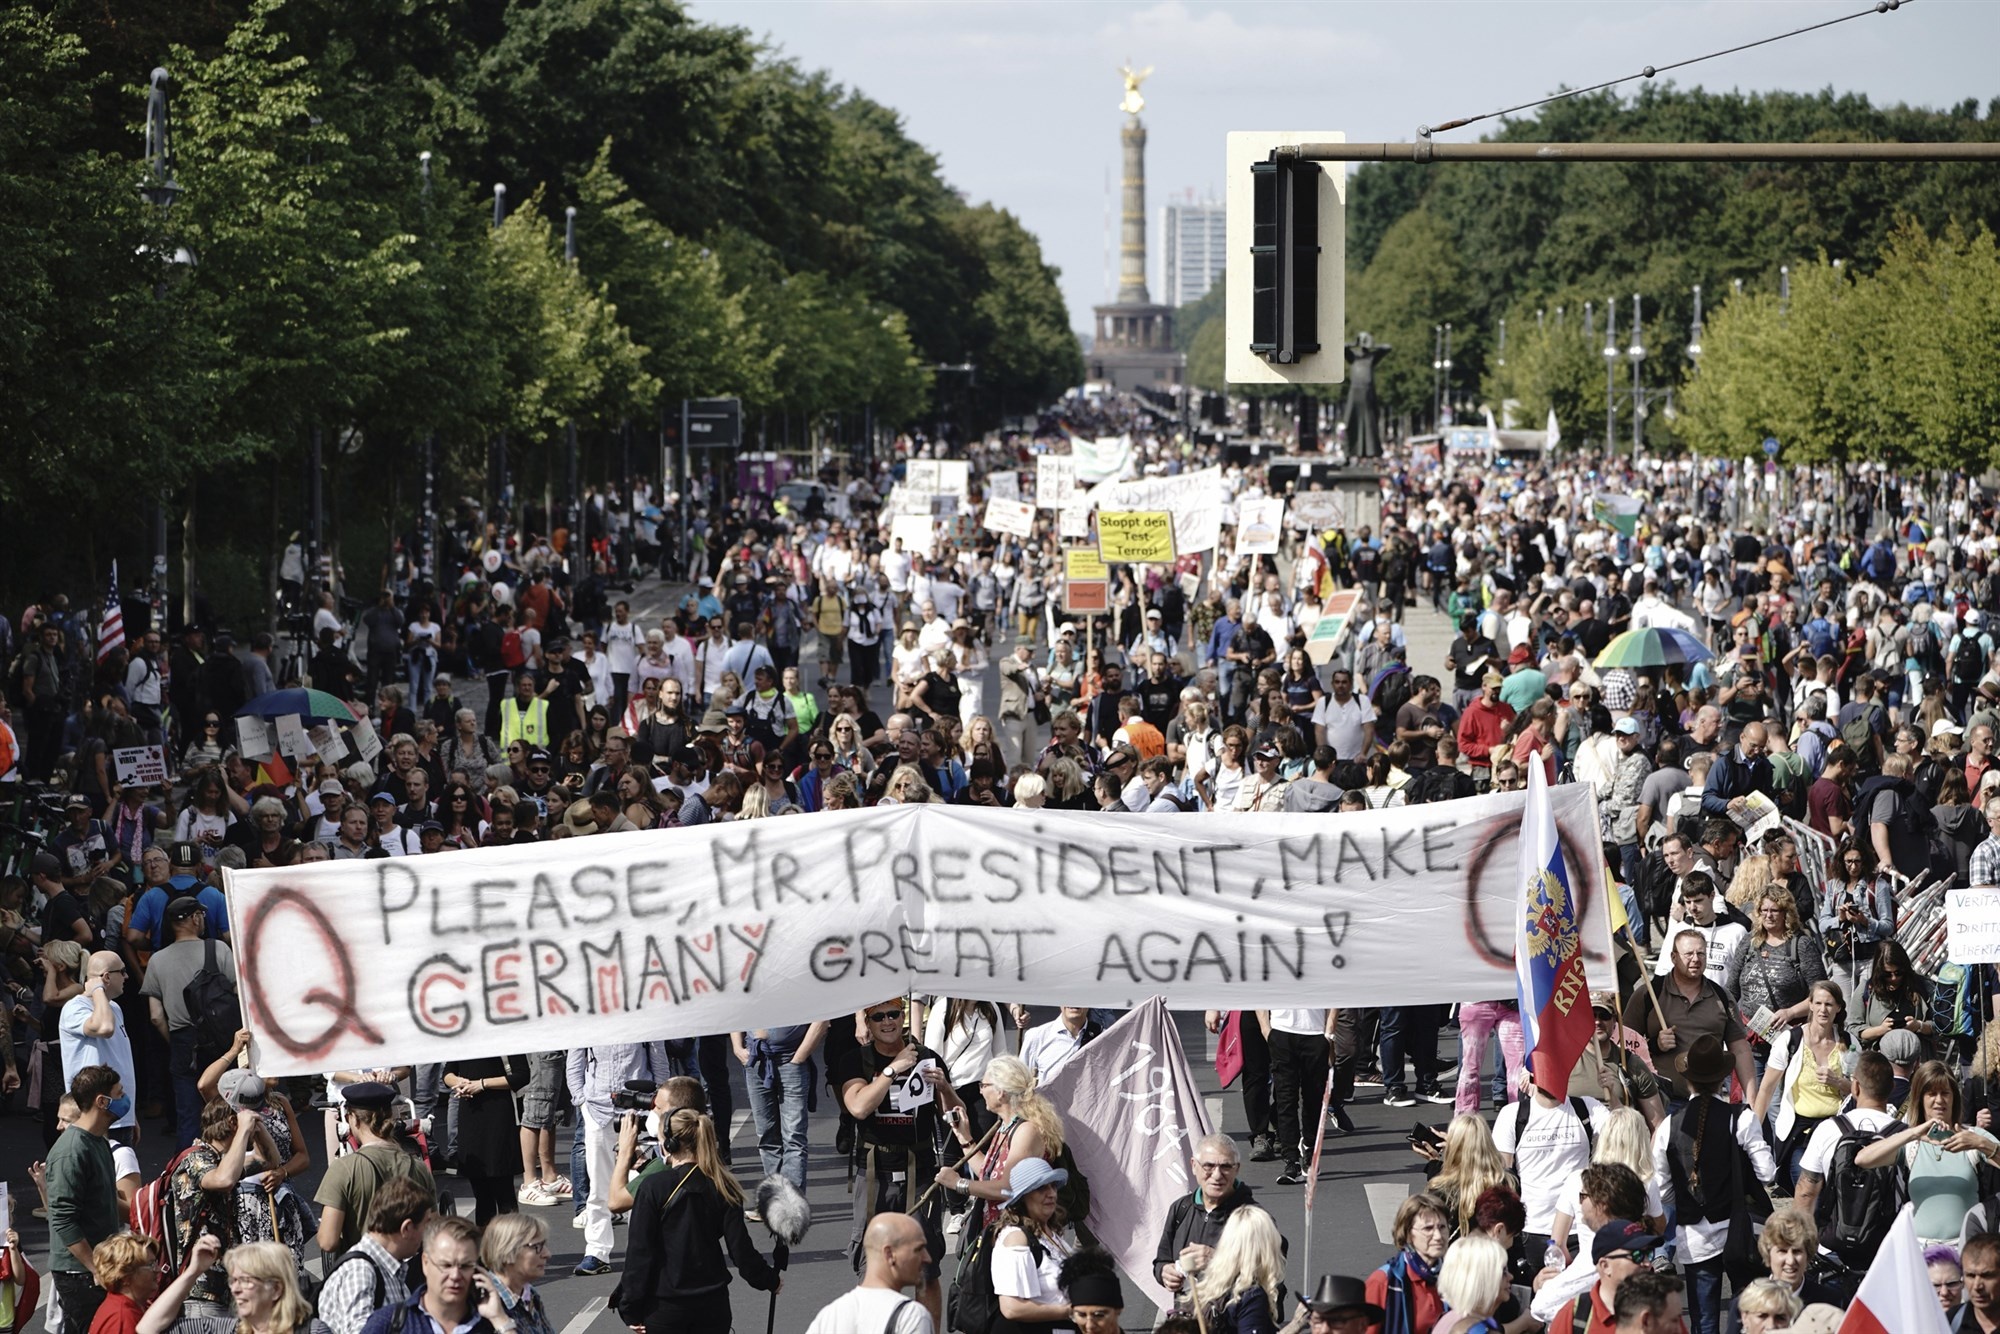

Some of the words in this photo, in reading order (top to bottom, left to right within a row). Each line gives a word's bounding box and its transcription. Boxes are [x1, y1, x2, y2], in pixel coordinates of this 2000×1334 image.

[1100, 517, 1140, 528] Stoppt
[1144, 517, 1166, 528] den
[1122, 532, 1154, 541] Test-
[118, 756, 137, 765] VIREN
[376, 860, 698, 945] PLEASE,
[1278, 820, 1460, 891] MAKE
[242, 884, 385, 1062] Q
[407, 917, 775, 1038] GERMANY
[809, 924, 1057, 983] GREAT
[909, 1072, 924, 1098] Q
[1526, 1131, 1575, 1143] QUERDENKEN
